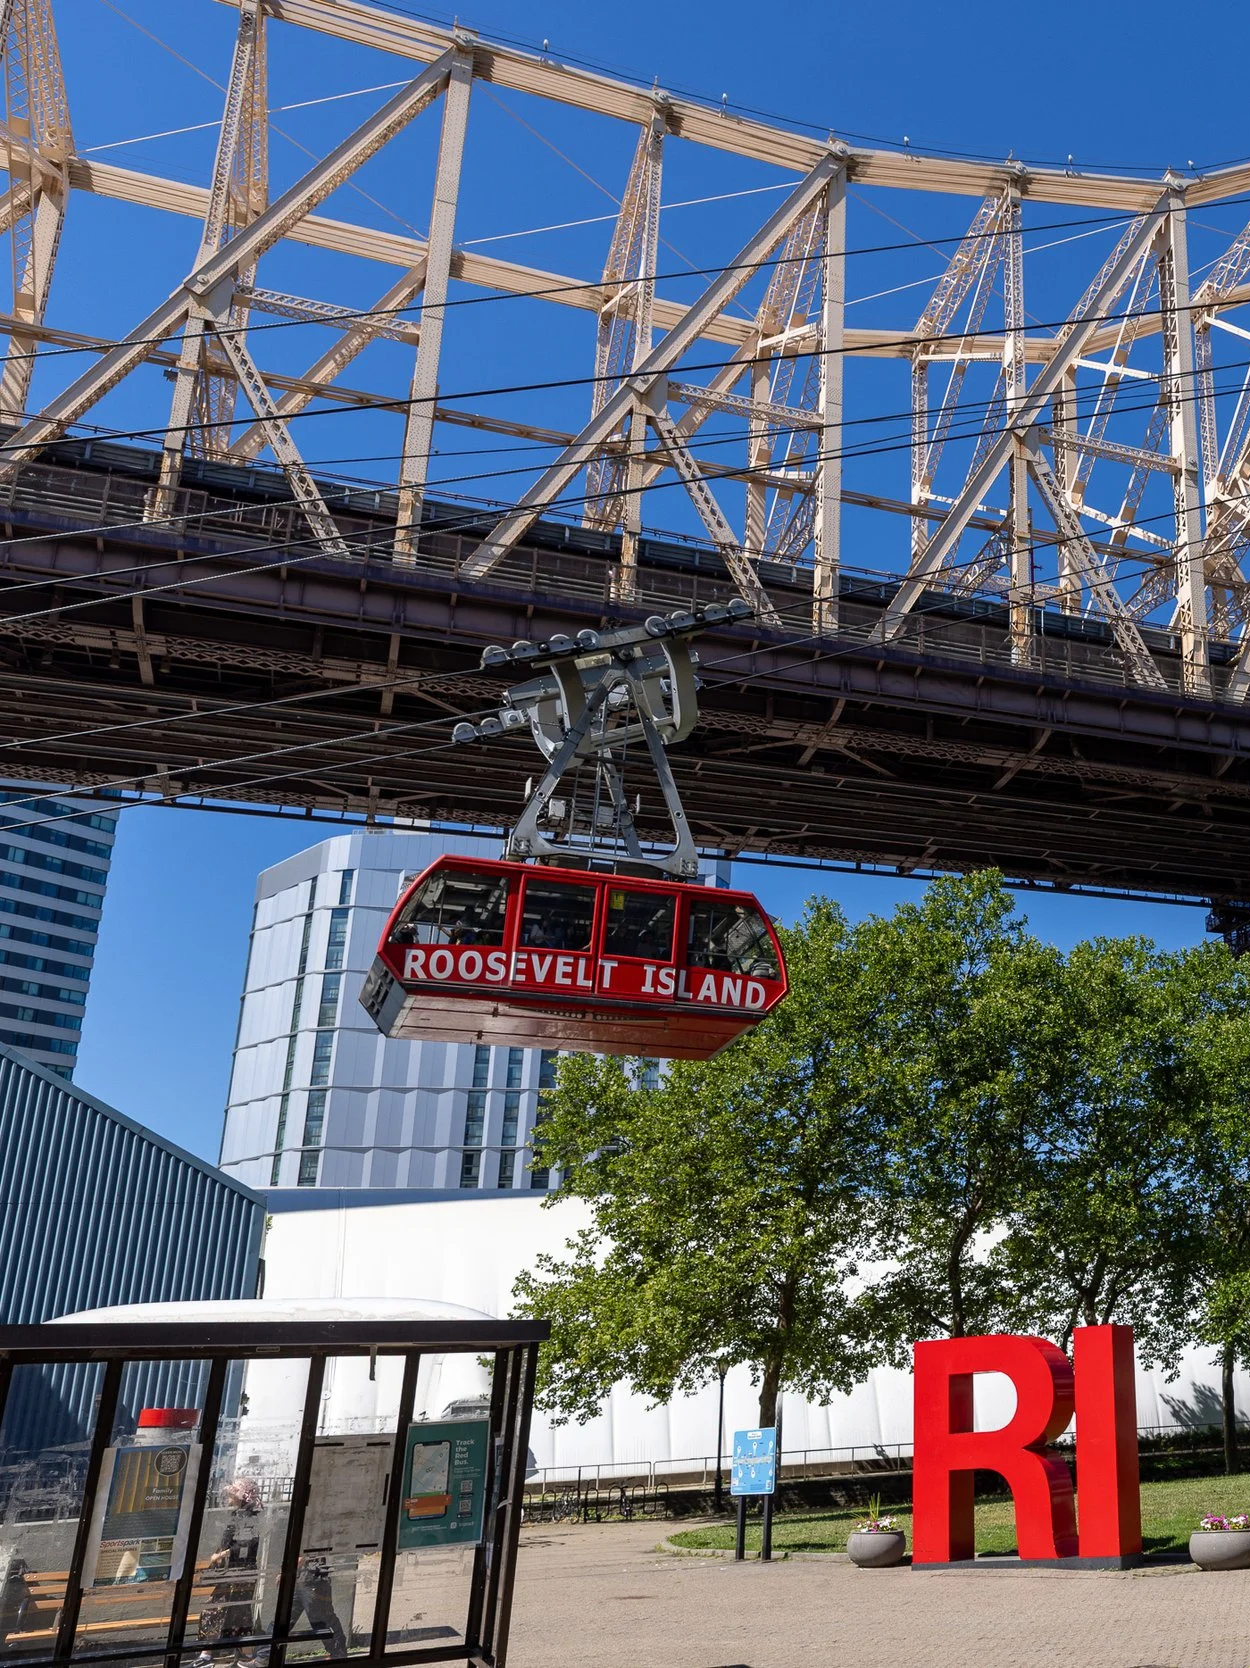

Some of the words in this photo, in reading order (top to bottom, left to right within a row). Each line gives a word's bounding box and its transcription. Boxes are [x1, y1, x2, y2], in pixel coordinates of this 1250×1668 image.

[403, 949, 618, 988] ROOSEVELT
[641, 964, 767, 1010] ISLAND
[912, 1324, 1143, 1563] RI
